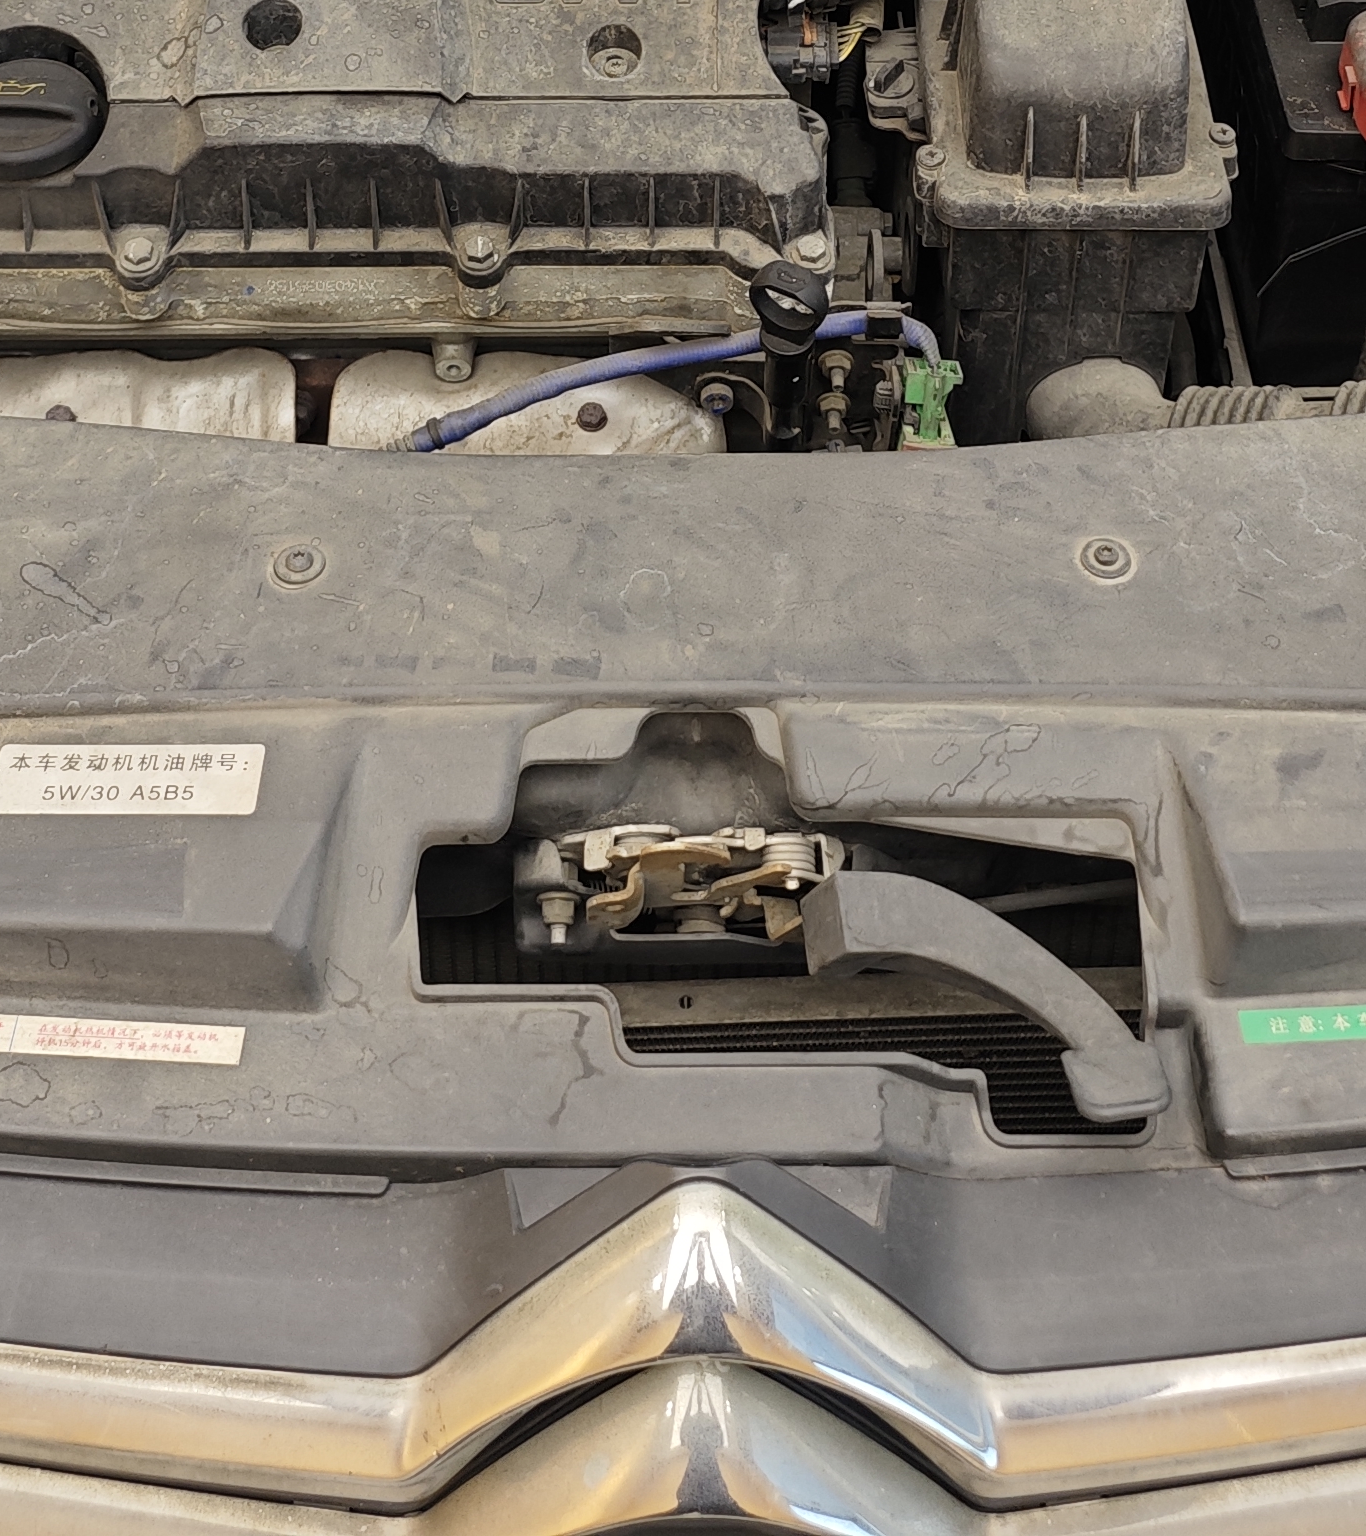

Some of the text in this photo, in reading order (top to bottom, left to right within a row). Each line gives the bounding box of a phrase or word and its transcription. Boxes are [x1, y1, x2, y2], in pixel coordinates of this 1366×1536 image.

[9, 752, 249, 773] 本车发动机机油牌号:
[41, 784, 195, 802] 5W/30 A5B5
